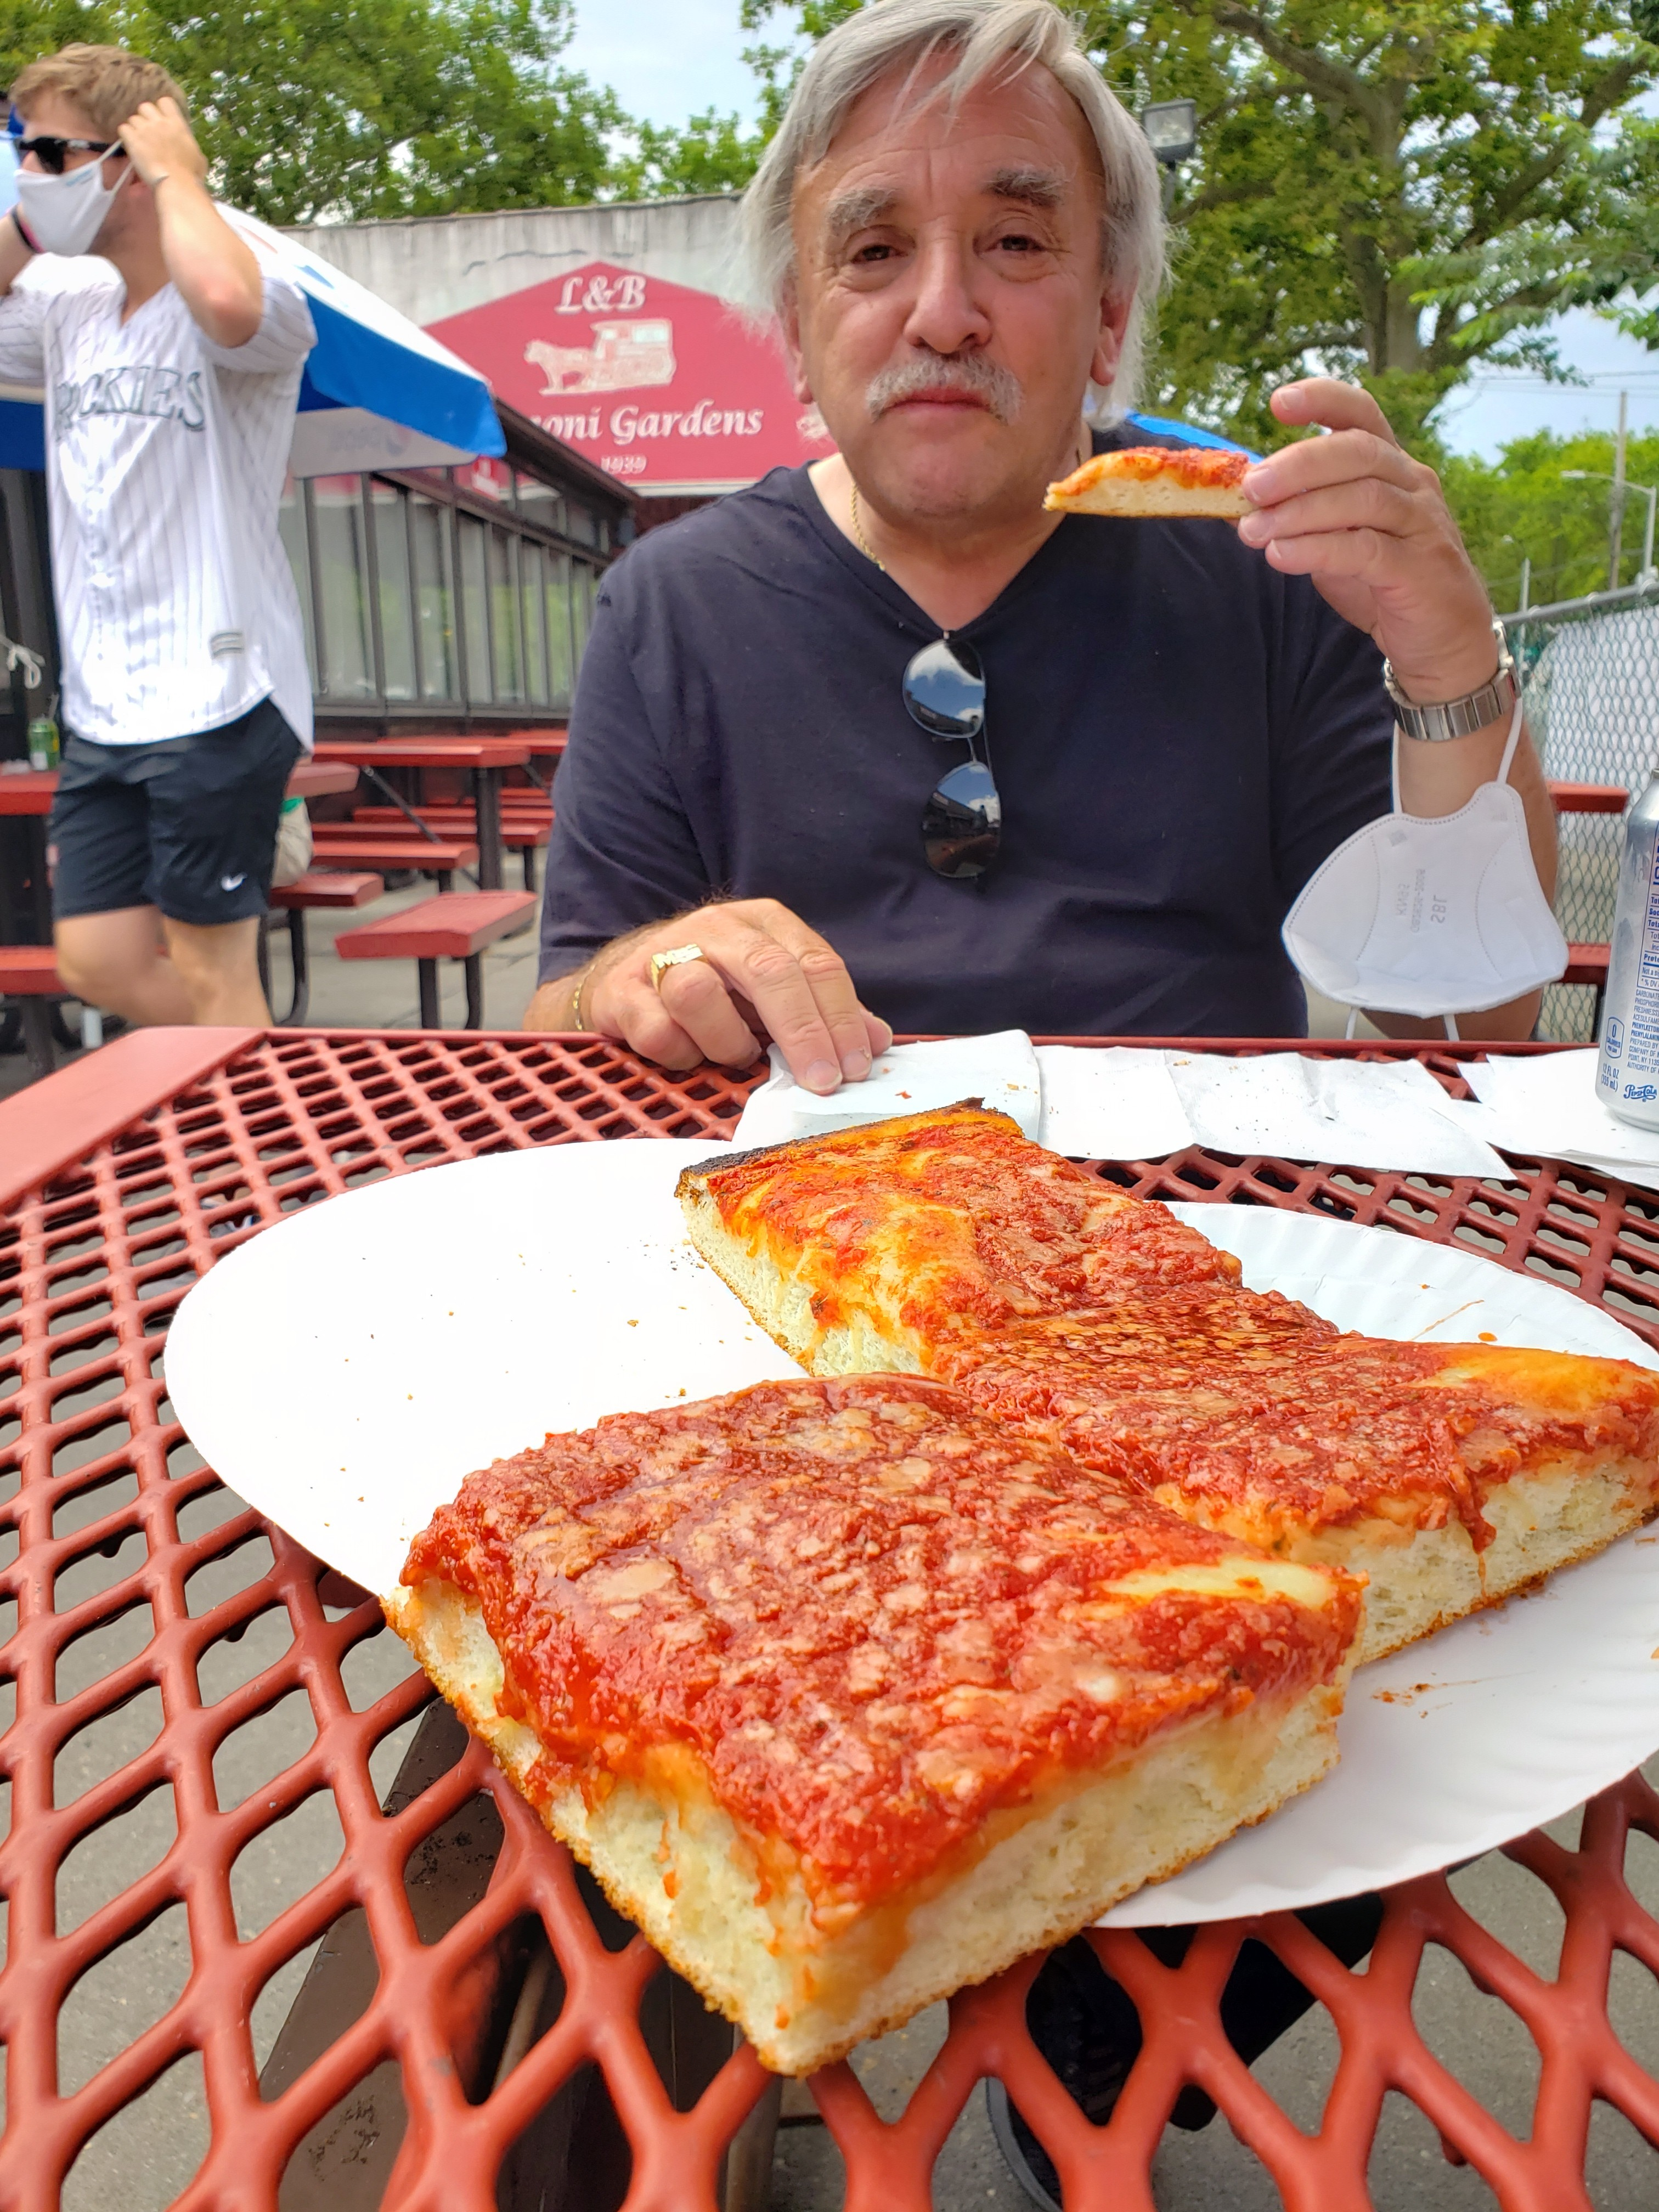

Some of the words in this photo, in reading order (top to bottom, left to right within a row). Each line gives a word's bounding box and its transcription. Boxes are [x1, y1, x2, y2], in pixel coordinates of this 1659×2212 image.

[554, 274, 646, 314] L&B
[55, 365, 205, 439] RCKIES
[609, 398, 764, 445] Gardens
[600, 453, 647, 475] 1939
[1612, 1024, 1617, 1038] 0
